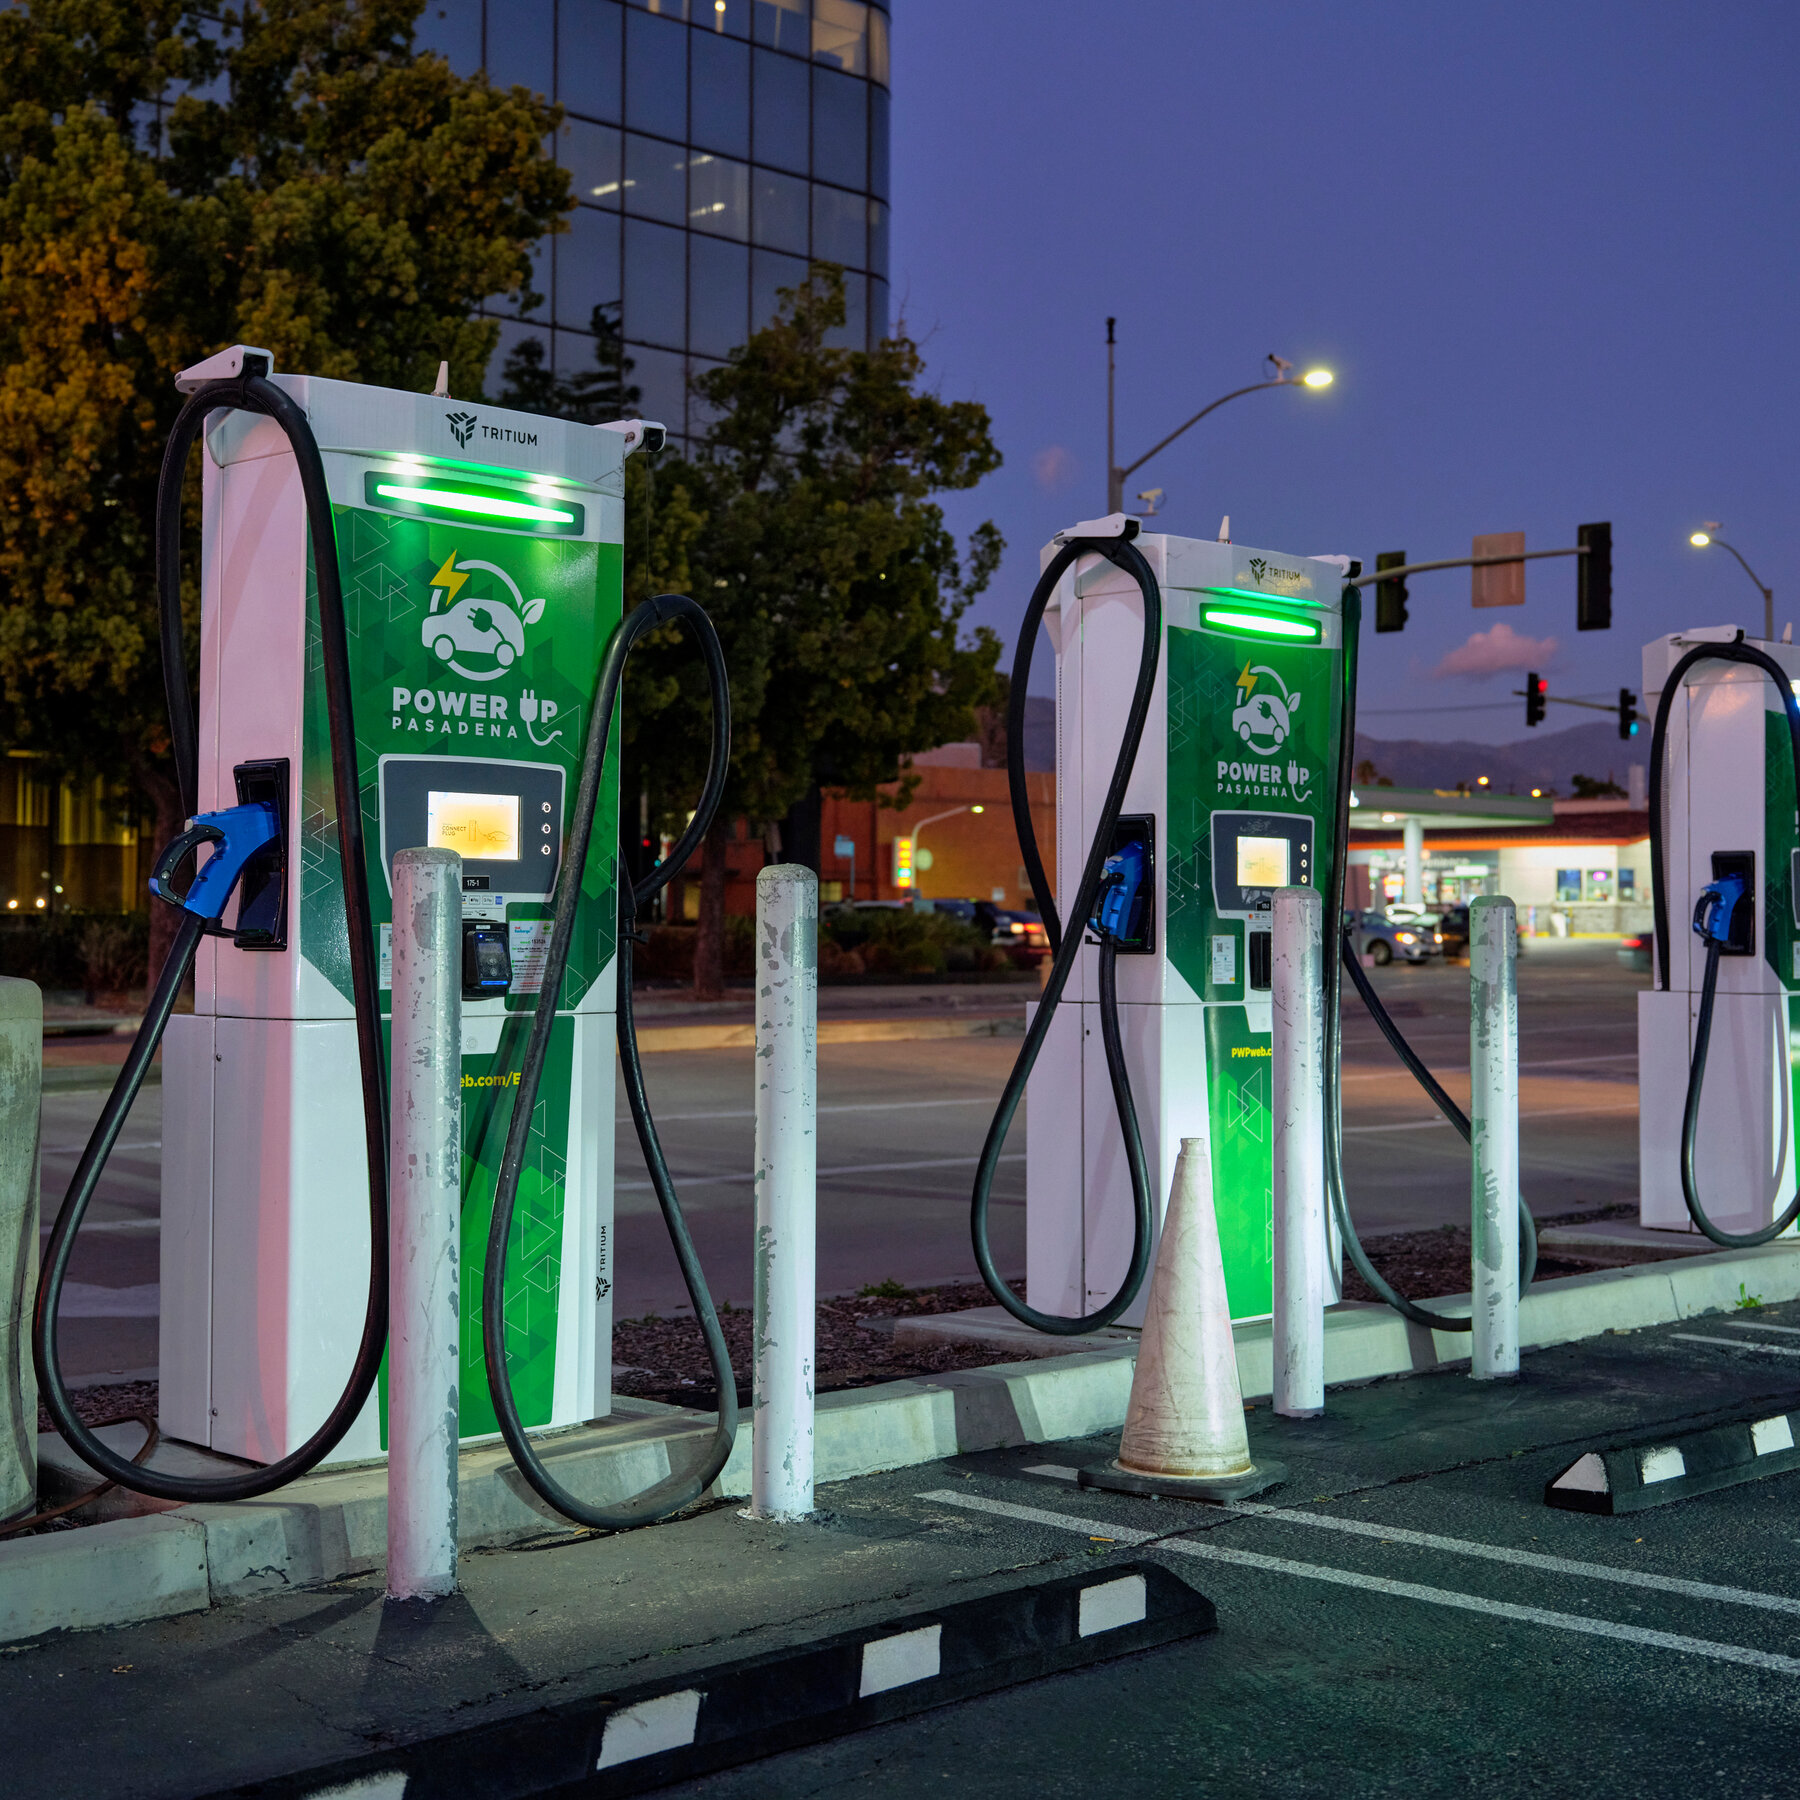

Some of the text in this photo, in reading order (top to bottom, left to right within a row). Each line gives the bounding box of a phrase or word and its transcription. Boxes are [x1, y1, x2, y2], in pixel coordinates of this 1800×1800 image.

[481, 425, 538, 446] TRITIUM
[1269, 567, 1301, 581] TRITIUM
[392, 686, 558, 724] POWER UP
[392, 716, 518, 739] PASADENA
[1217, 761, 1310, 785] POWER UP
[1217, 783, 1288, 797] PASADENA
[466, 879, 480, 888] 175-1
[1231, 1046, 1272, 1058] PWPweb.c
[460, 1071, 521, 1088] eb.com/E
